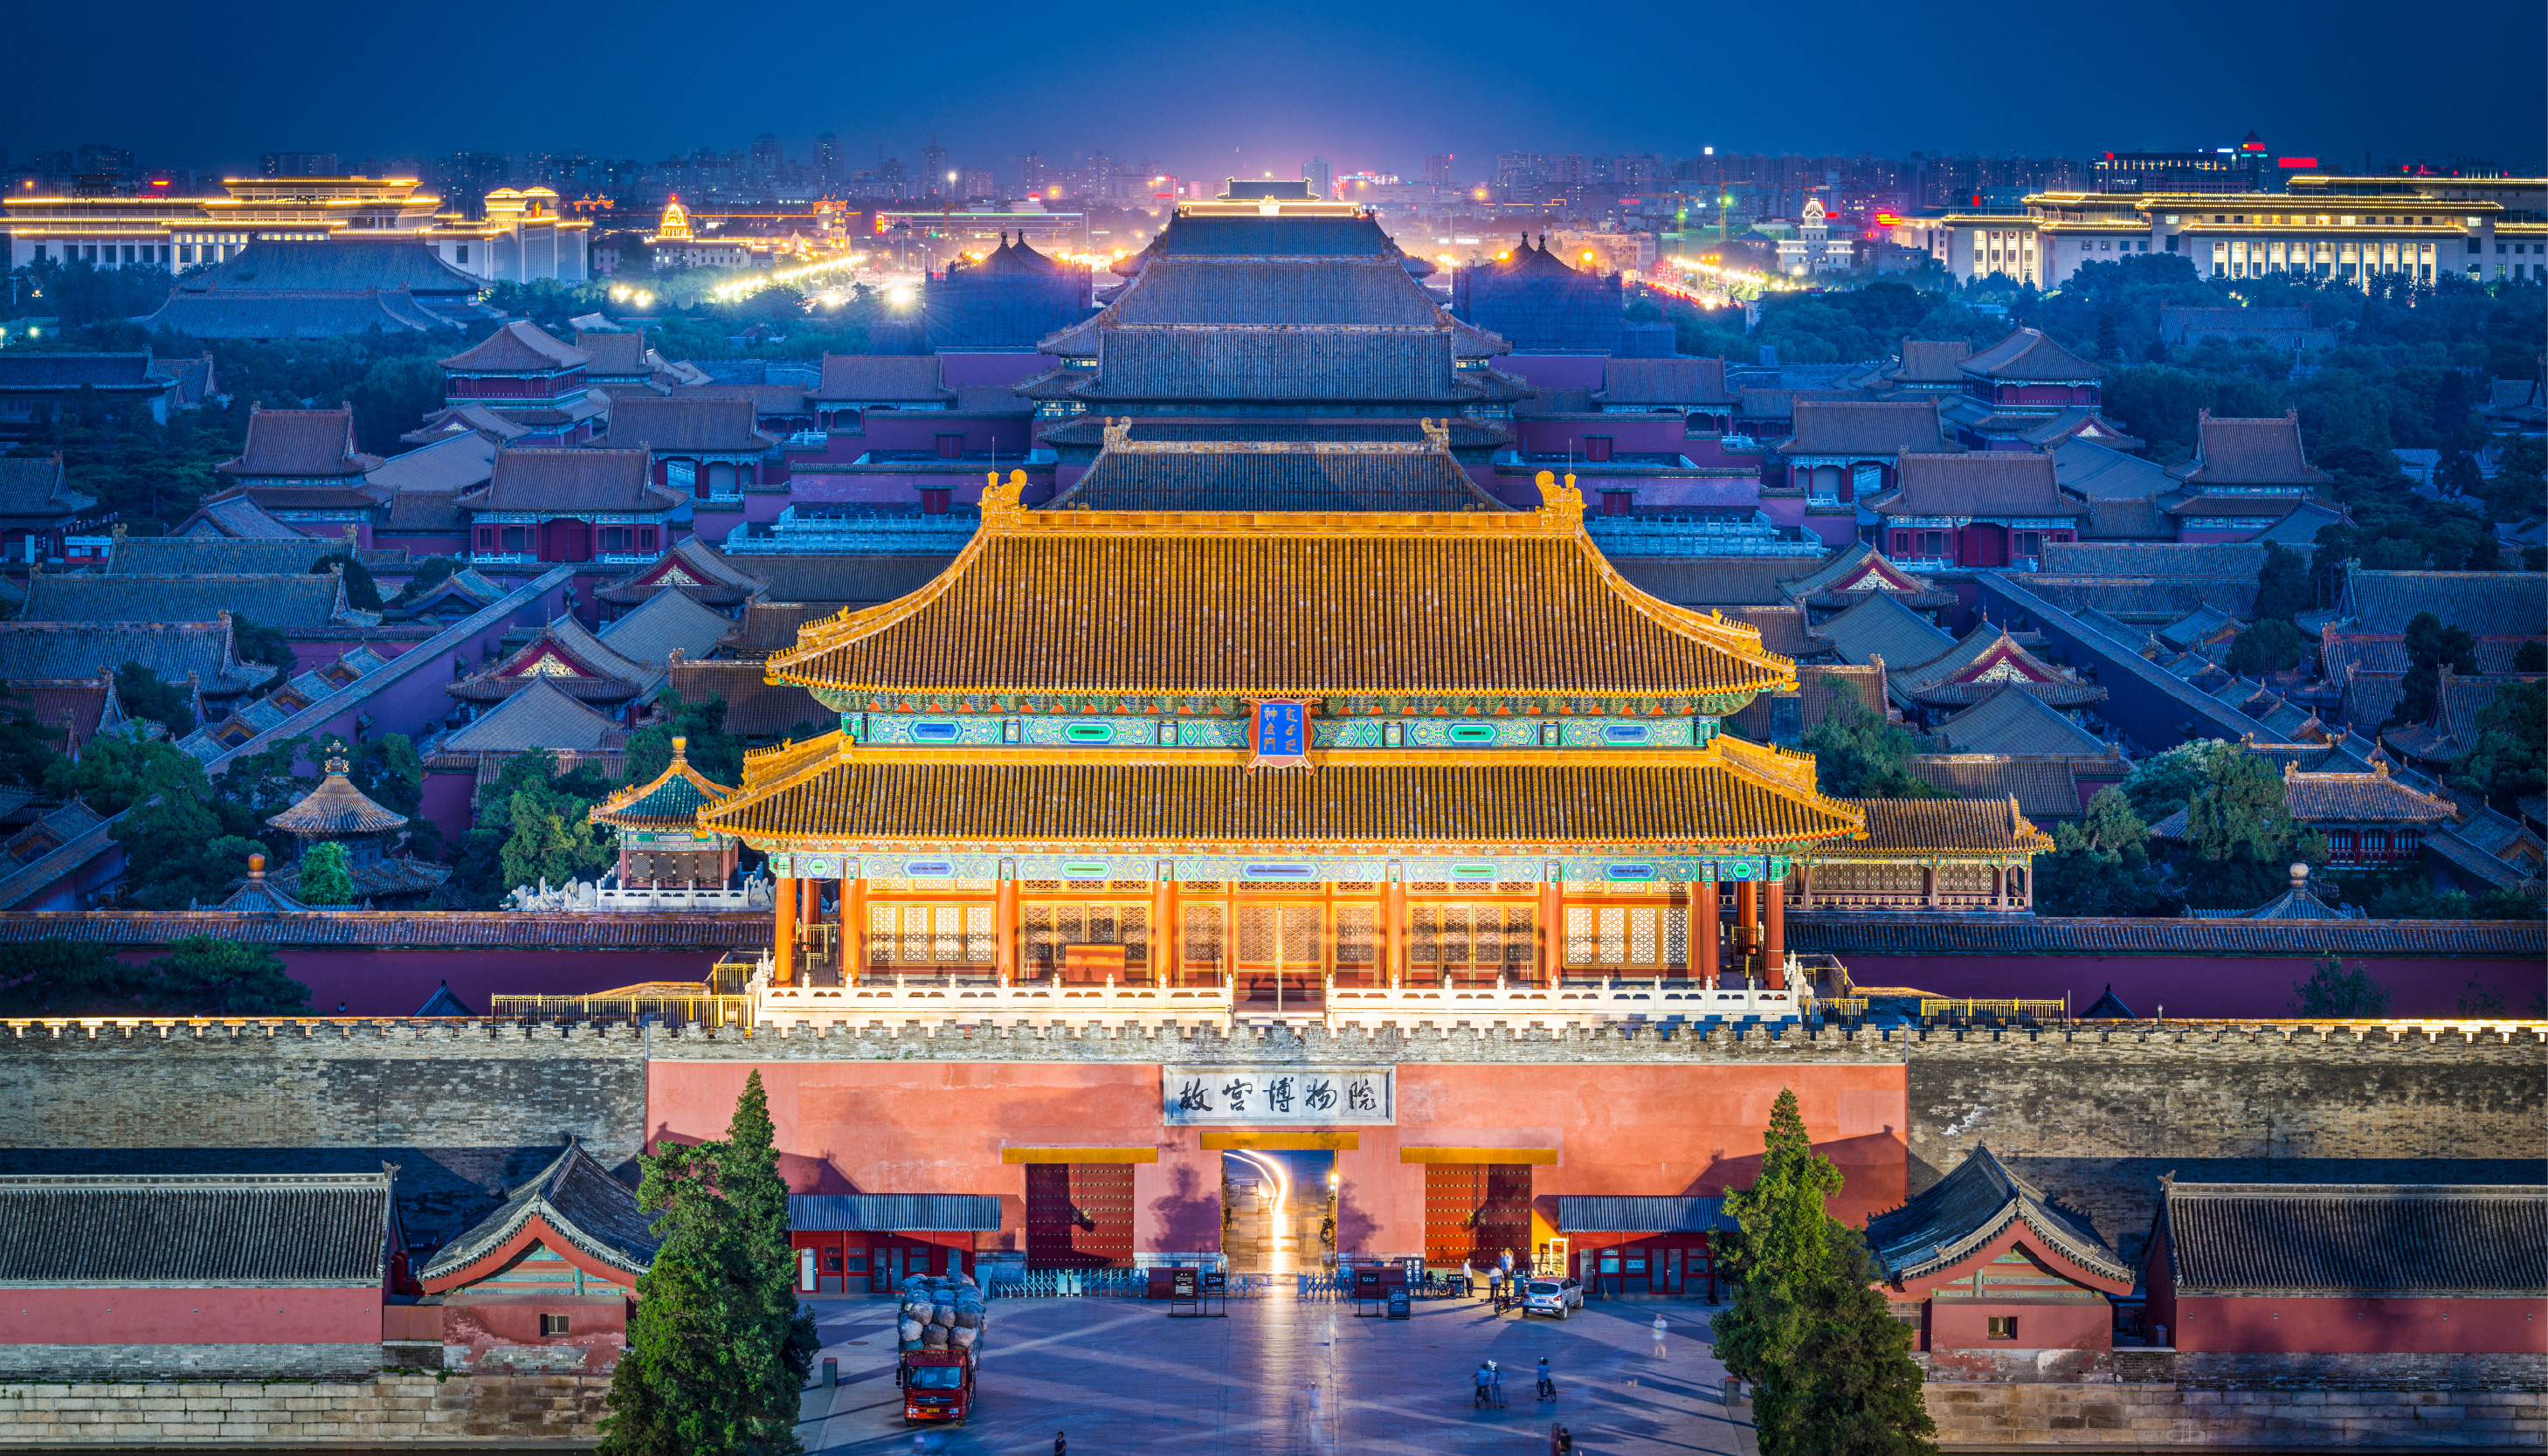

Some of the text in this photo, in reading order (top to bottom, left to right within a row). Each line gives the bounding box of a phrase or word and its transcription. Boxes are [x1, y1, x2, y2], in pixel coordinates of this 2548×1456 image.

[1264, 707, 1278, 752] 神武門
[1178, 1076, 1378, 1113] 故宫博物院
